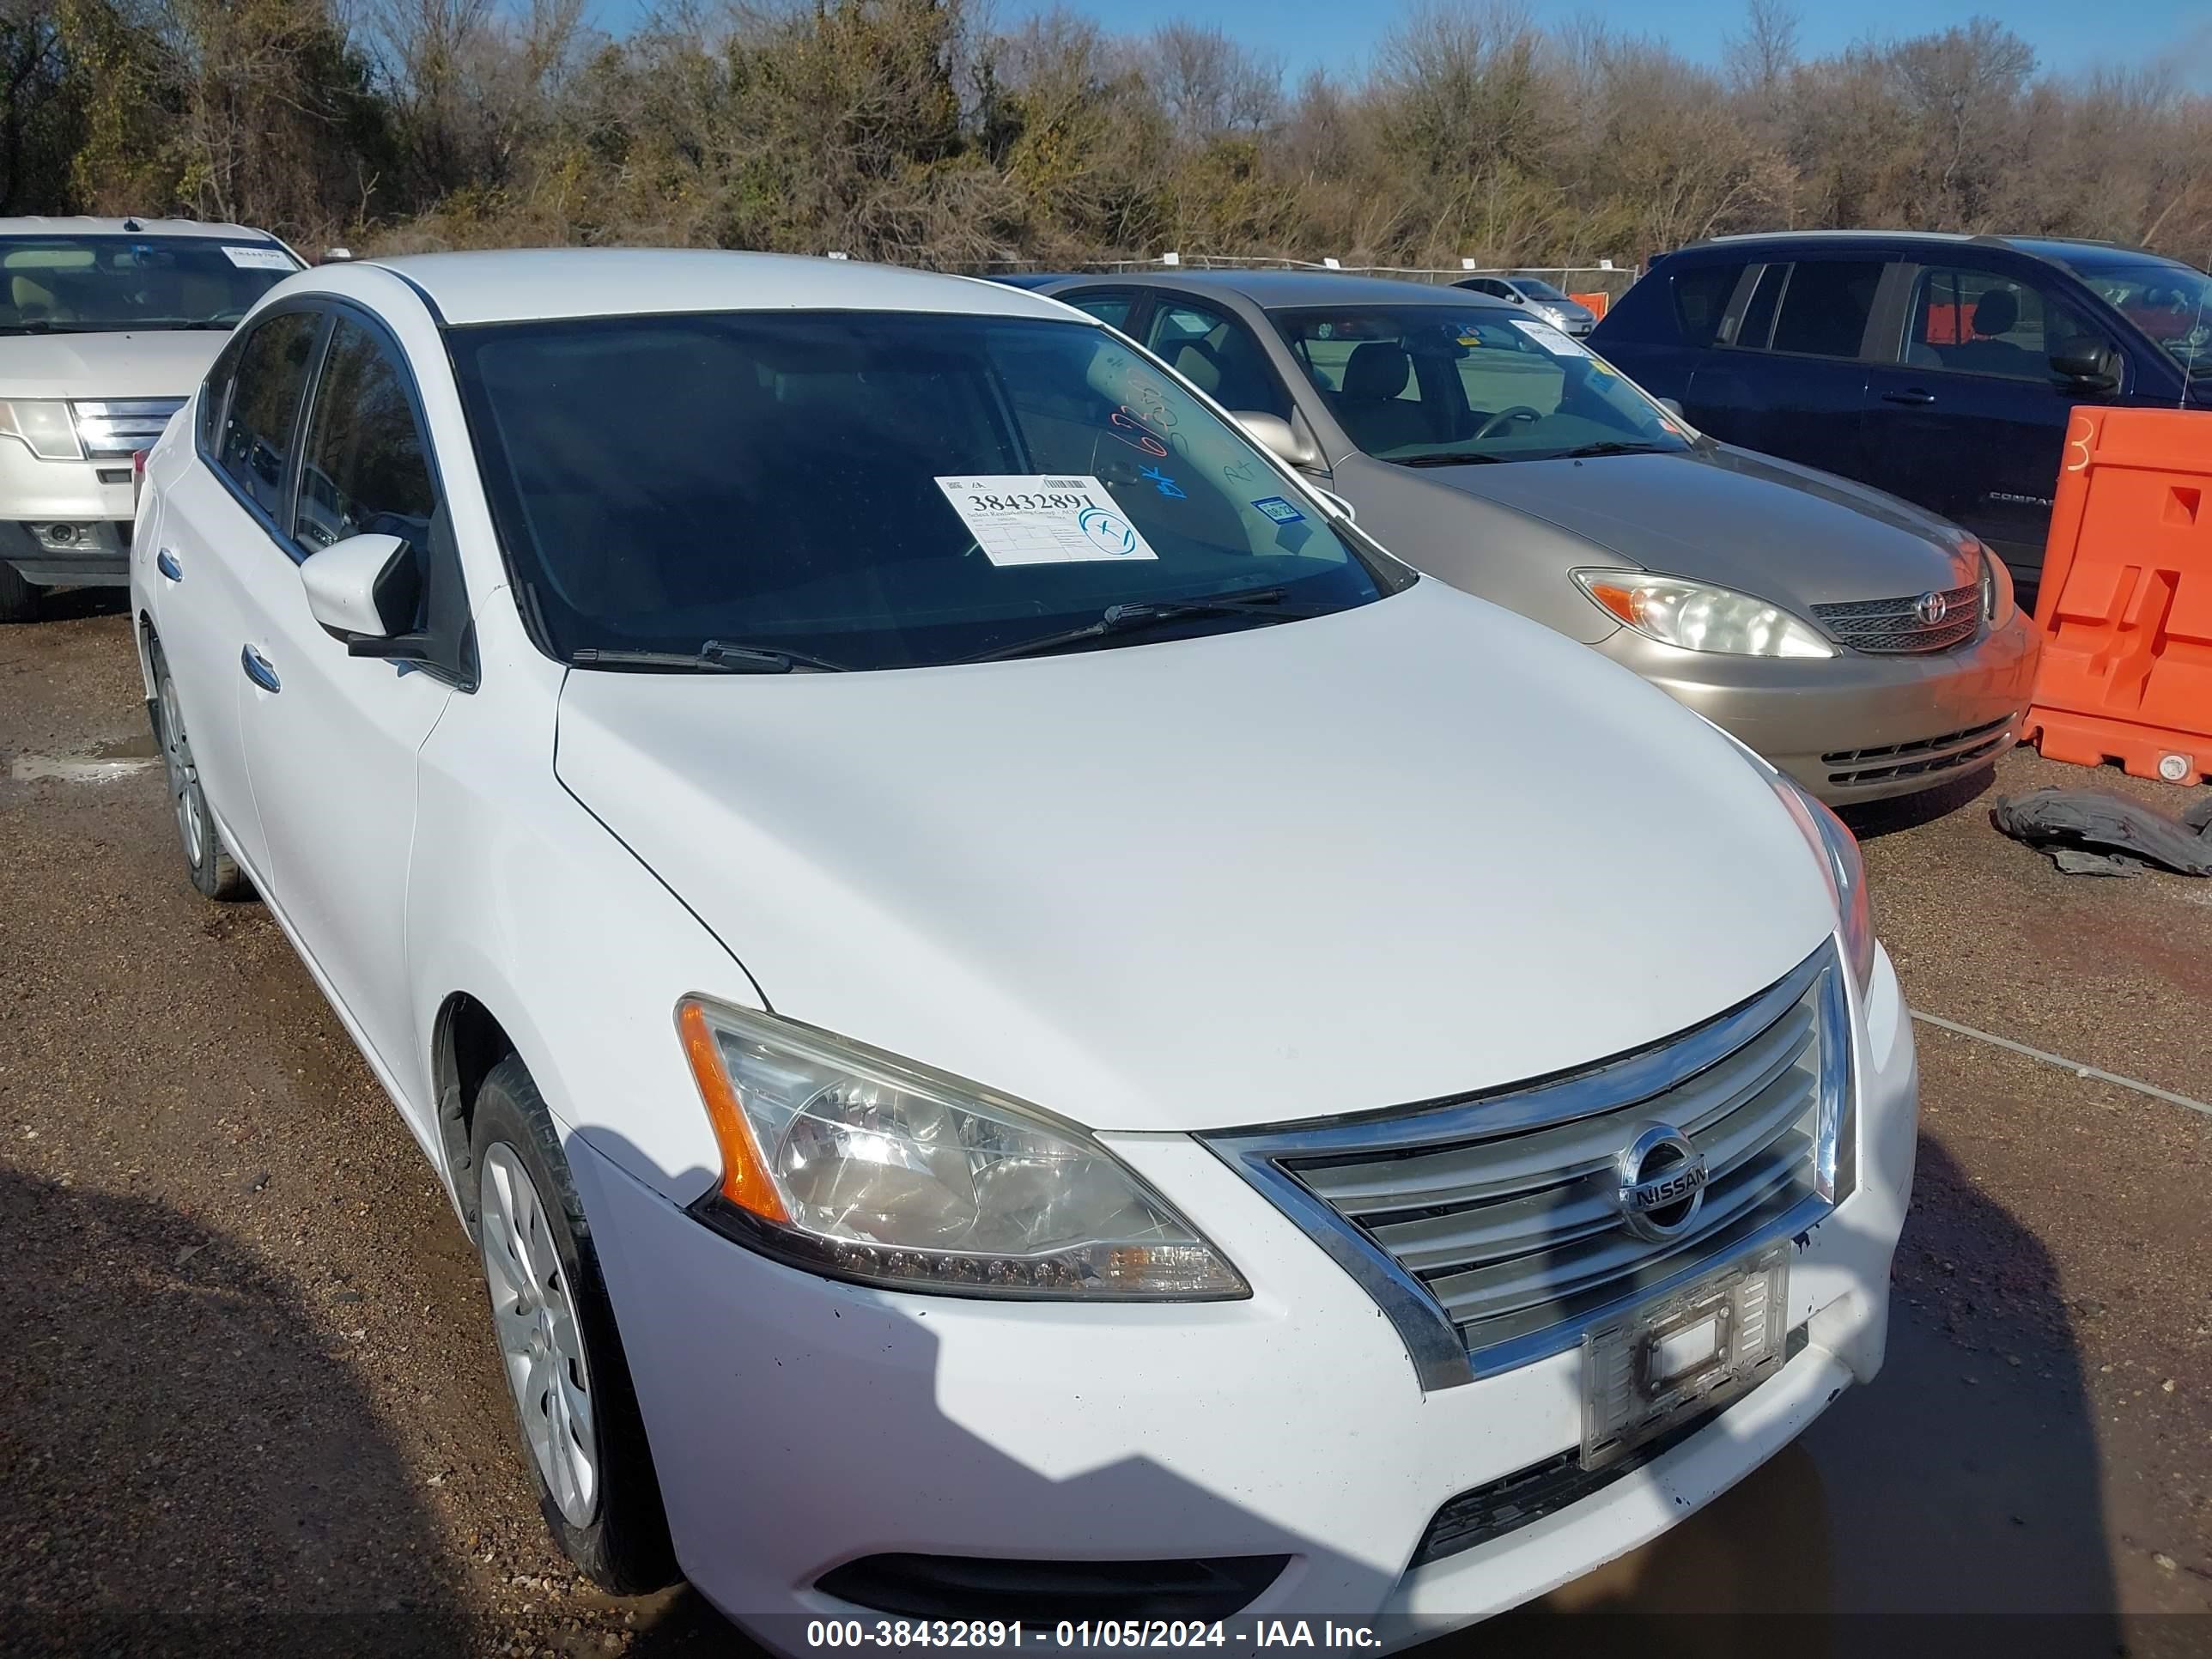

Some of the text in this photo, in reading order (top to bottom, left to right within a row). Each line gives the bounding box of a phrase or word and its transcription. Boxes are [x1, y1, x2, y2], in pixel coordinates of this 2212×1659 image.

[2068, 416, 2094, 471] 3
[968, 494, 1096, 512] 38432891
[1636, 1165, 1706, 1206] NISSAN
